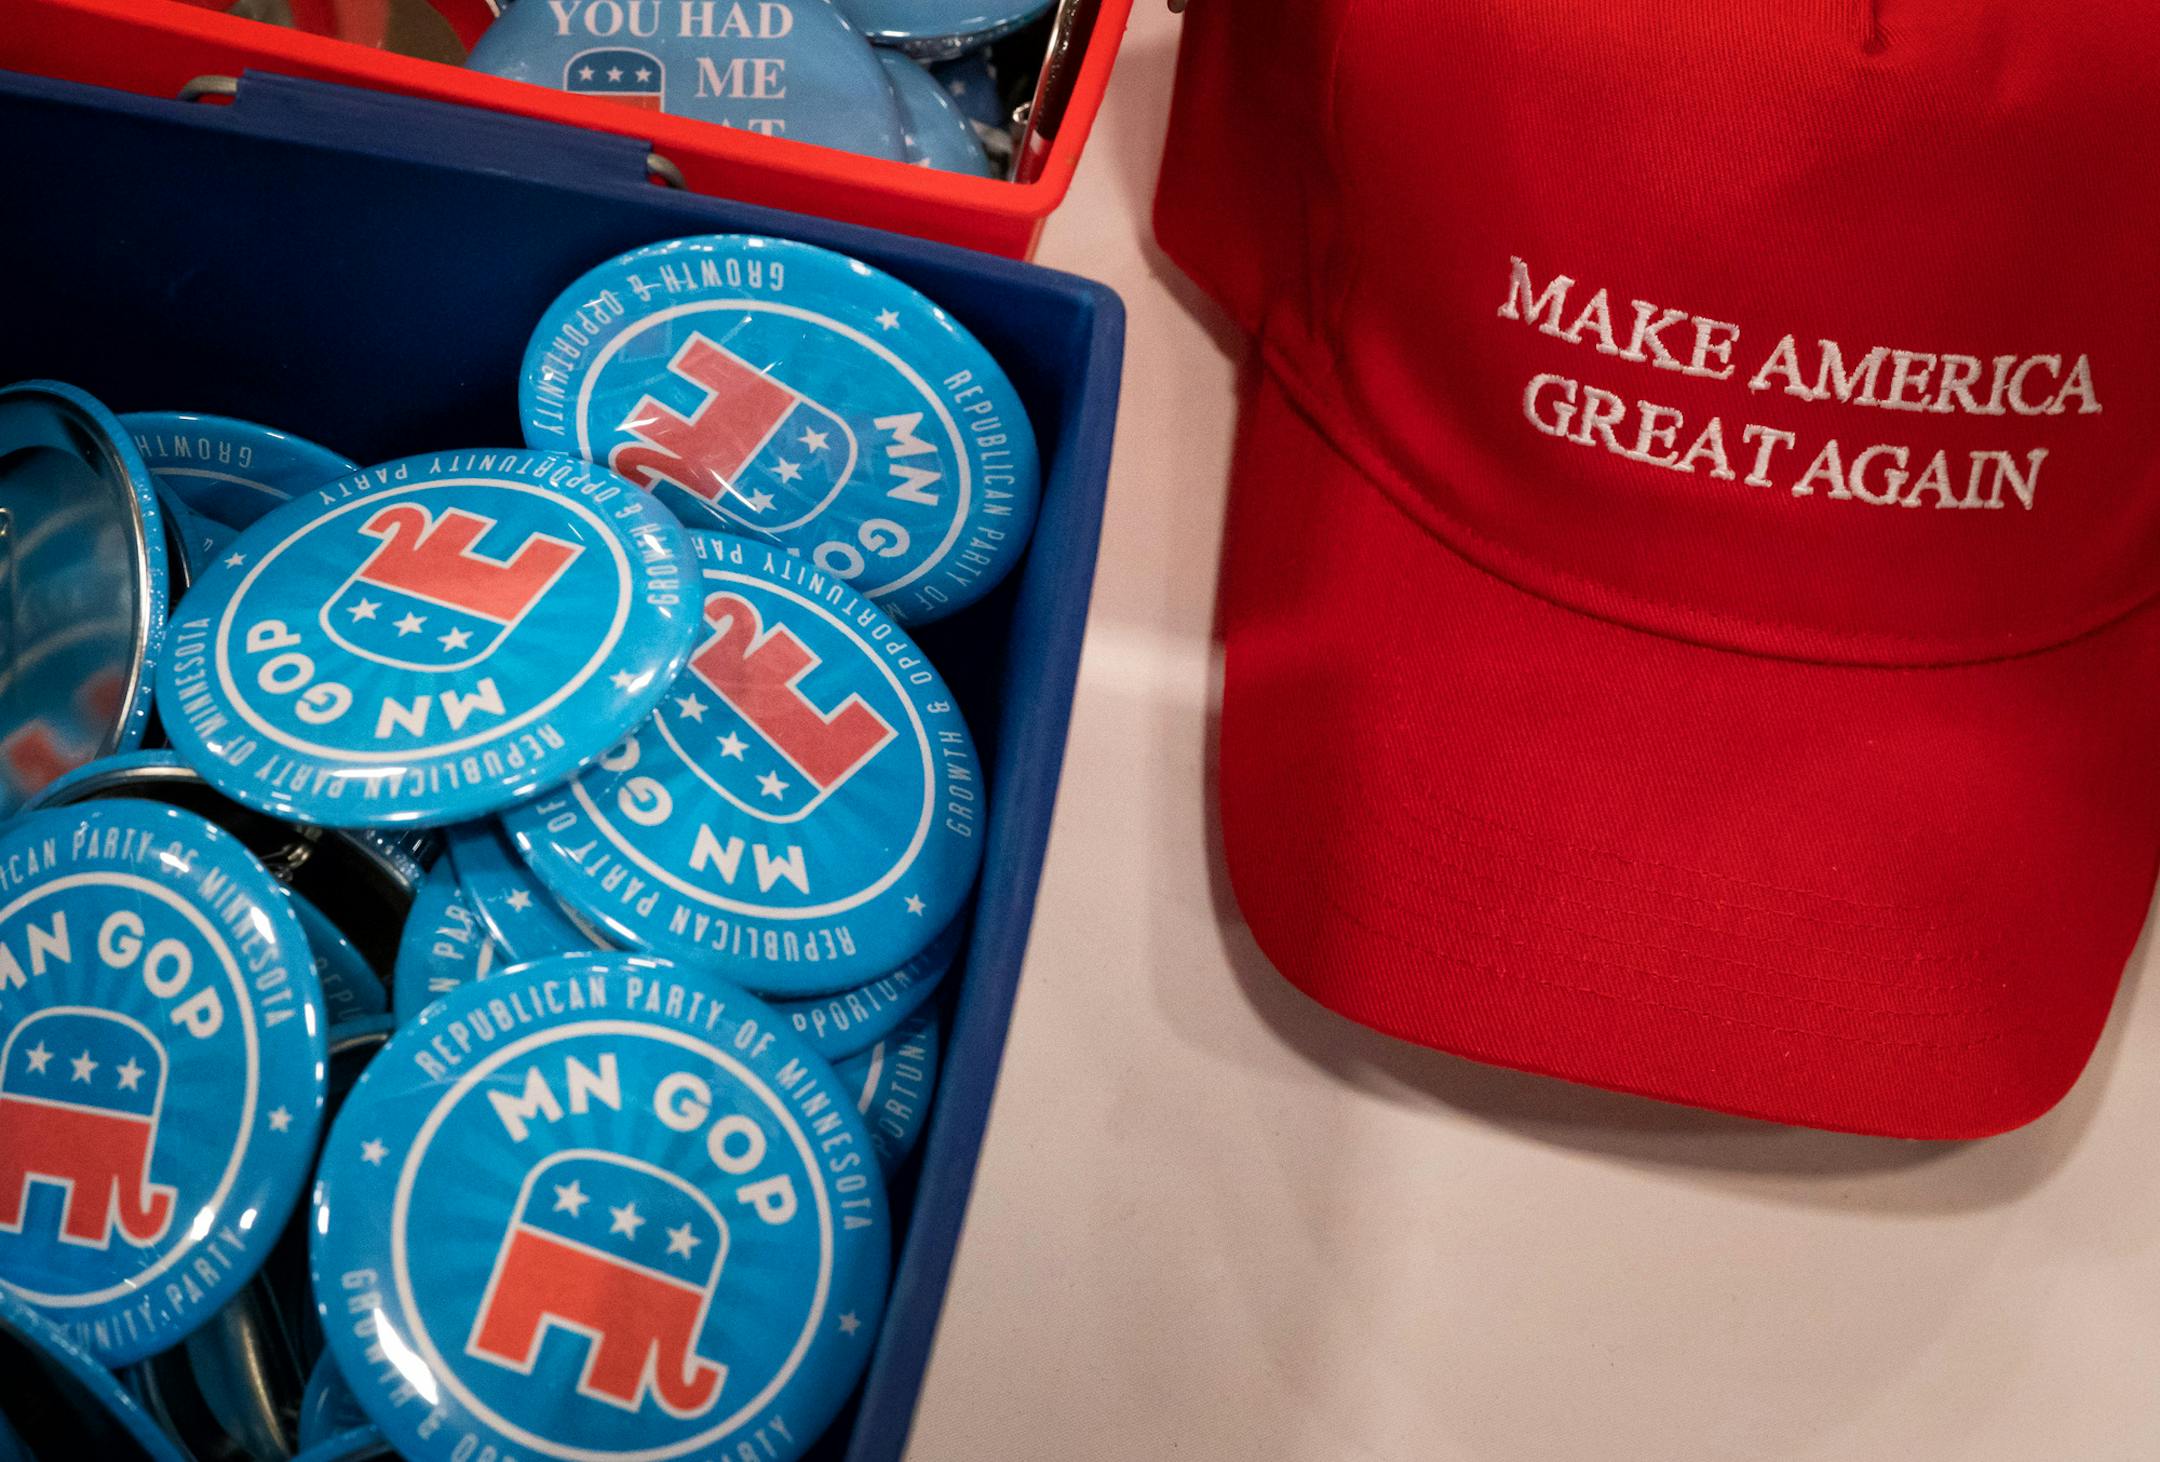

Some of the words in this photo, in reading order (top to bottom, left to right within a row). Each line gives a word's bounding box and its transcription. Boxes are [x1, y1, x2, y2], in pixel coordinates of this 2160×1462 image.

[550, 0, 661, 37] YOU
[677, 1, 794, 38] HAD
[694, 56, 786, 99] ME
[626, 274, 652, 302] &
[659, 258, 784, 293] GROWTH
[532, 289, 625, 436] OPPORTUNITY
[1497, 255, 1740, 380] MAKE
[1748, 333, 2103, 415] AMERICA
[137, 433, 253, 469] GROWTH
[873, 411, 942, 506] MN
[943, 369, 1015, 516] REPUBLICAN
[1523, 372, 1795, 488] GREAT
[1792, 438, 2049, 510] AGAIN
[319, 463, 408, 506] PARTY
[429, 454, 622, 503] OPPORTUNITY
[615, 503, 643, 518] &
[691, 536, 743, 565] PAR
[788, 518, 910, 579] GO
[946, 526, 1006, 587] PARTY
[763, 551, 932, 685] OPPORTUNITY
[914, 584, 949, 612] OF
[174, 617, 228, 737] MINNESOTA
[246, 619, 353, 725] GOP
[374, 676, 507, 739] MN
[927, 700, 950, 713] &
[222, 735, 257, 766] OF
[254, 754, 348, 799] PARTY
[363, 723, 566, 799] REPUBLICAN
[600, 735, 673, 827] GO
[536, 801, 577, 832] OF
[938, 731, 975, 839] GROWTH
[565, 840, 660, 917] PARTY
[688, 823, 811, 895] MN
[72, 826, 154, 864] PARTY
[200, 866, 296, 1027] MINNESOTA
[669, 904, 858, 962] REPUBLICAN
[97, 910, 224, 1039] GOP
[414, 975, 607, 1081] REPUBLICAN
[626, 976, 725, 1031] PARTY
[734, 1018, 776, 1058] OF
[775, 1057, 873, 1231] MINNESOTA
[487, 1052, 622, 1142] MN
[653, 1071, 798, 1226] GOP
[166, 1226, 246, 1315] PARTY
